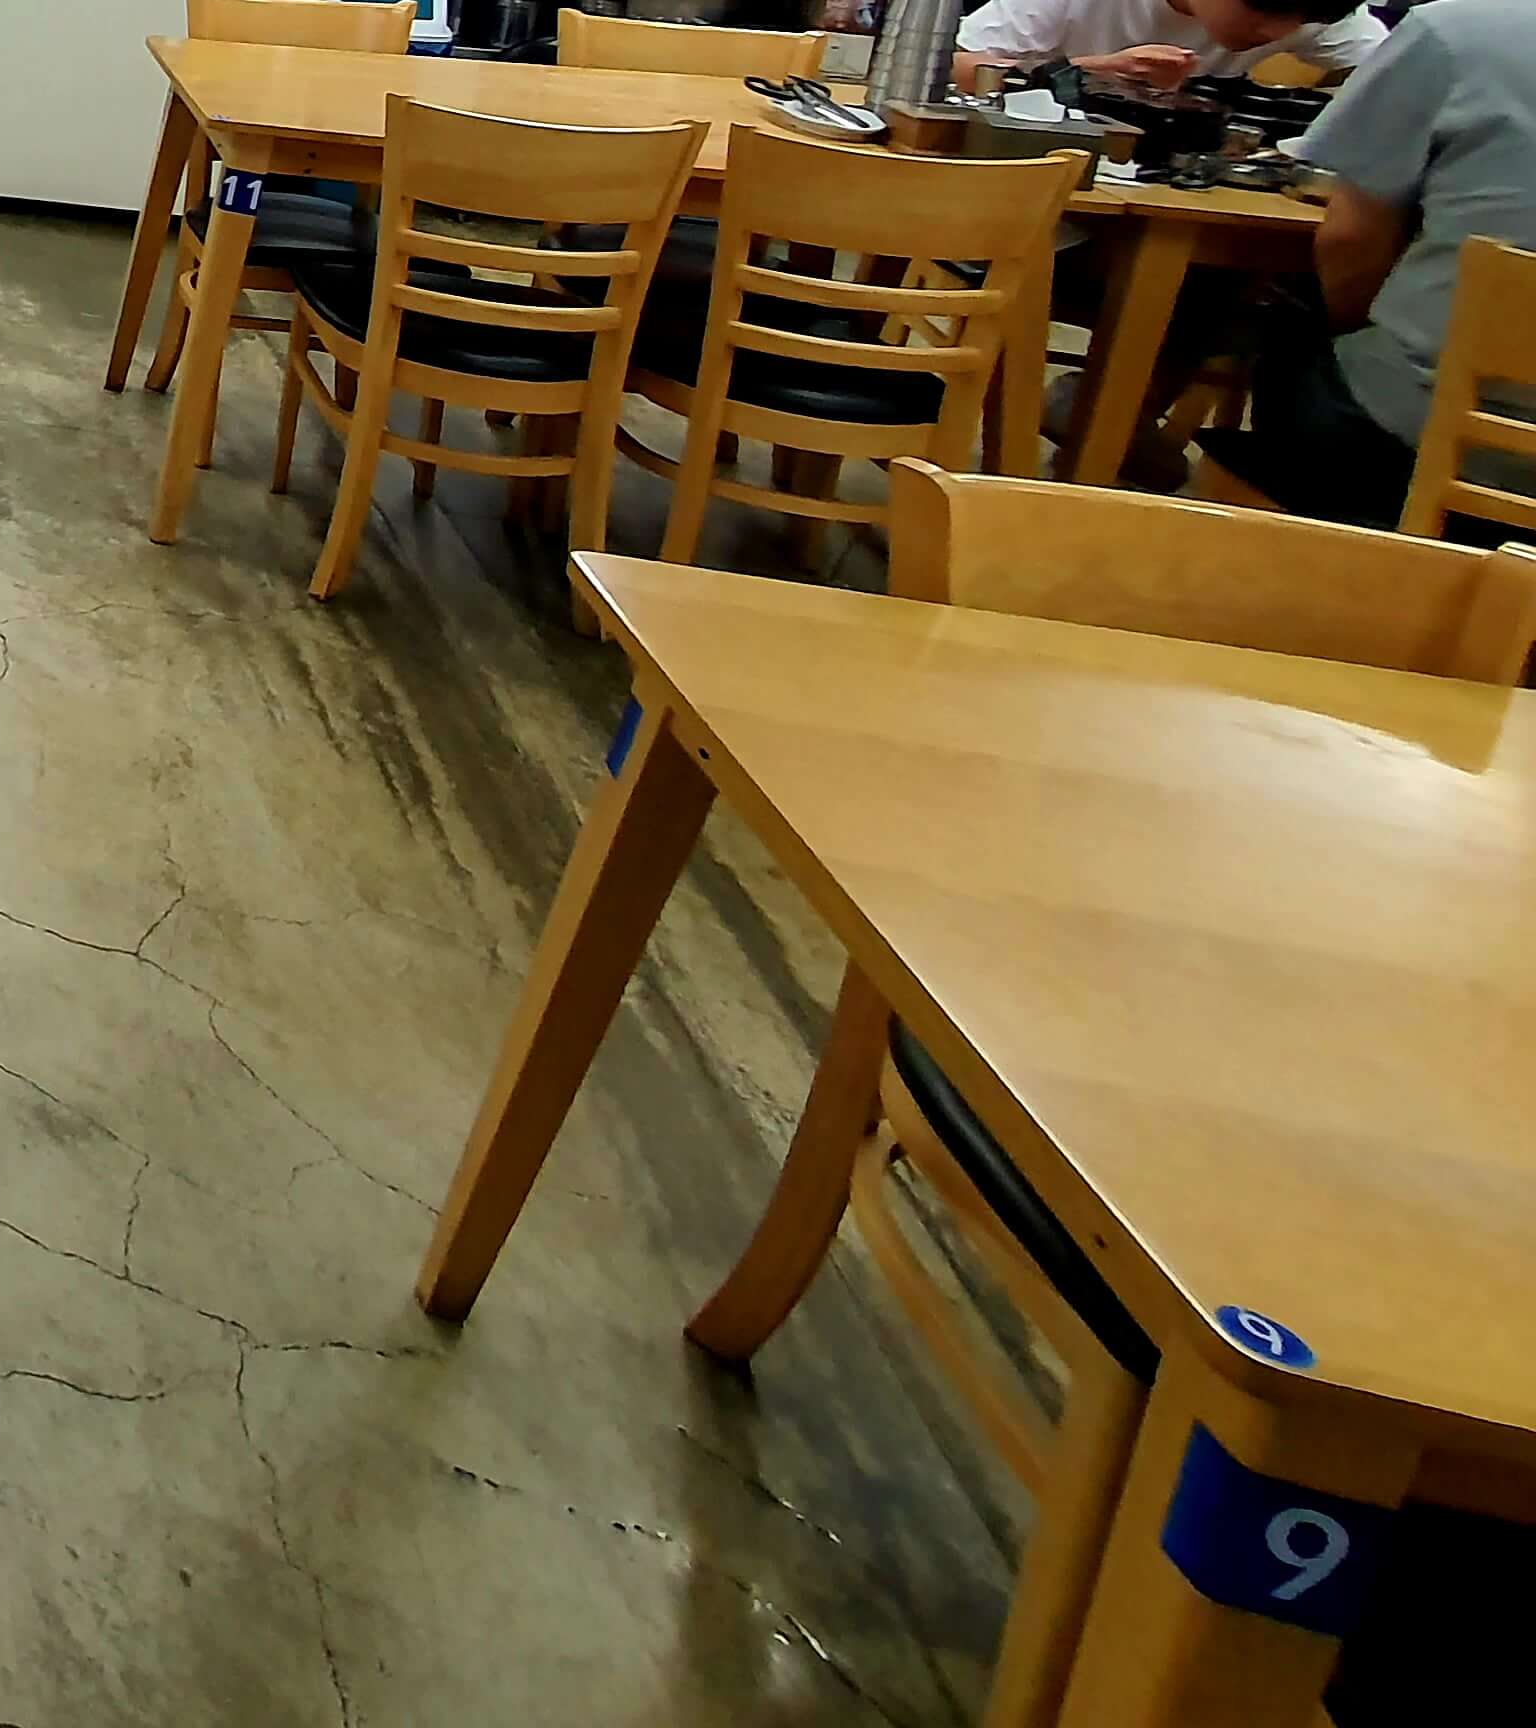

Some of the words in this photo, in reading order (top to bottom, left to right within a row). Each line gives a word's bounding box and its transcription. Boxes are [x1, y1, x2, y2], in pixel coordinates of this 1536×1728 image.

[224, 175, 262, 209] 11
[1238, 1310, 1283, 1356] 9
[1265, 1508, 1350, 1601] 9
